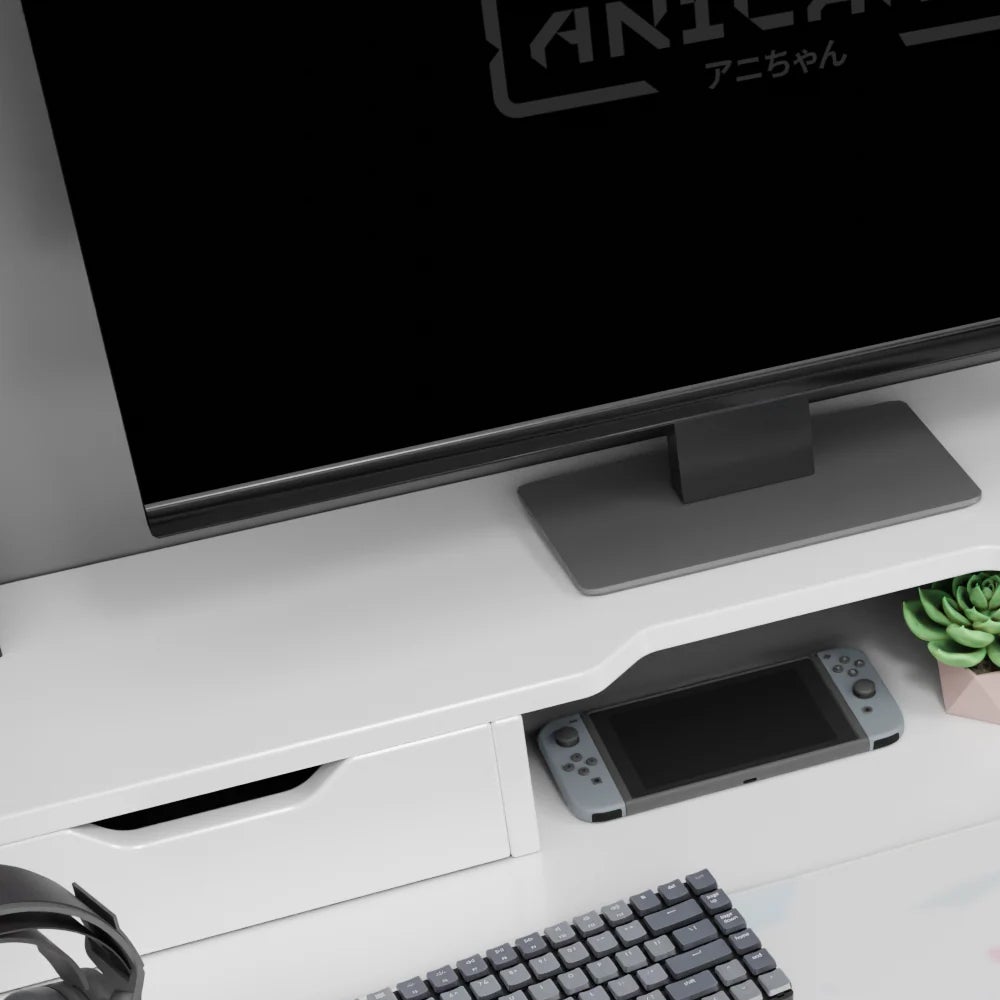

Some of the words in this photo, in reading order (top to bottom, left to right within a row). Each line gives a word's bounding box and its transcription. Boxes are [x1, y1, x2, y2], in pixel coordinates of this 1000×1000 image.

[705, 40, 847, 90] アニちゃん
[734, 932, 750, 941] home
